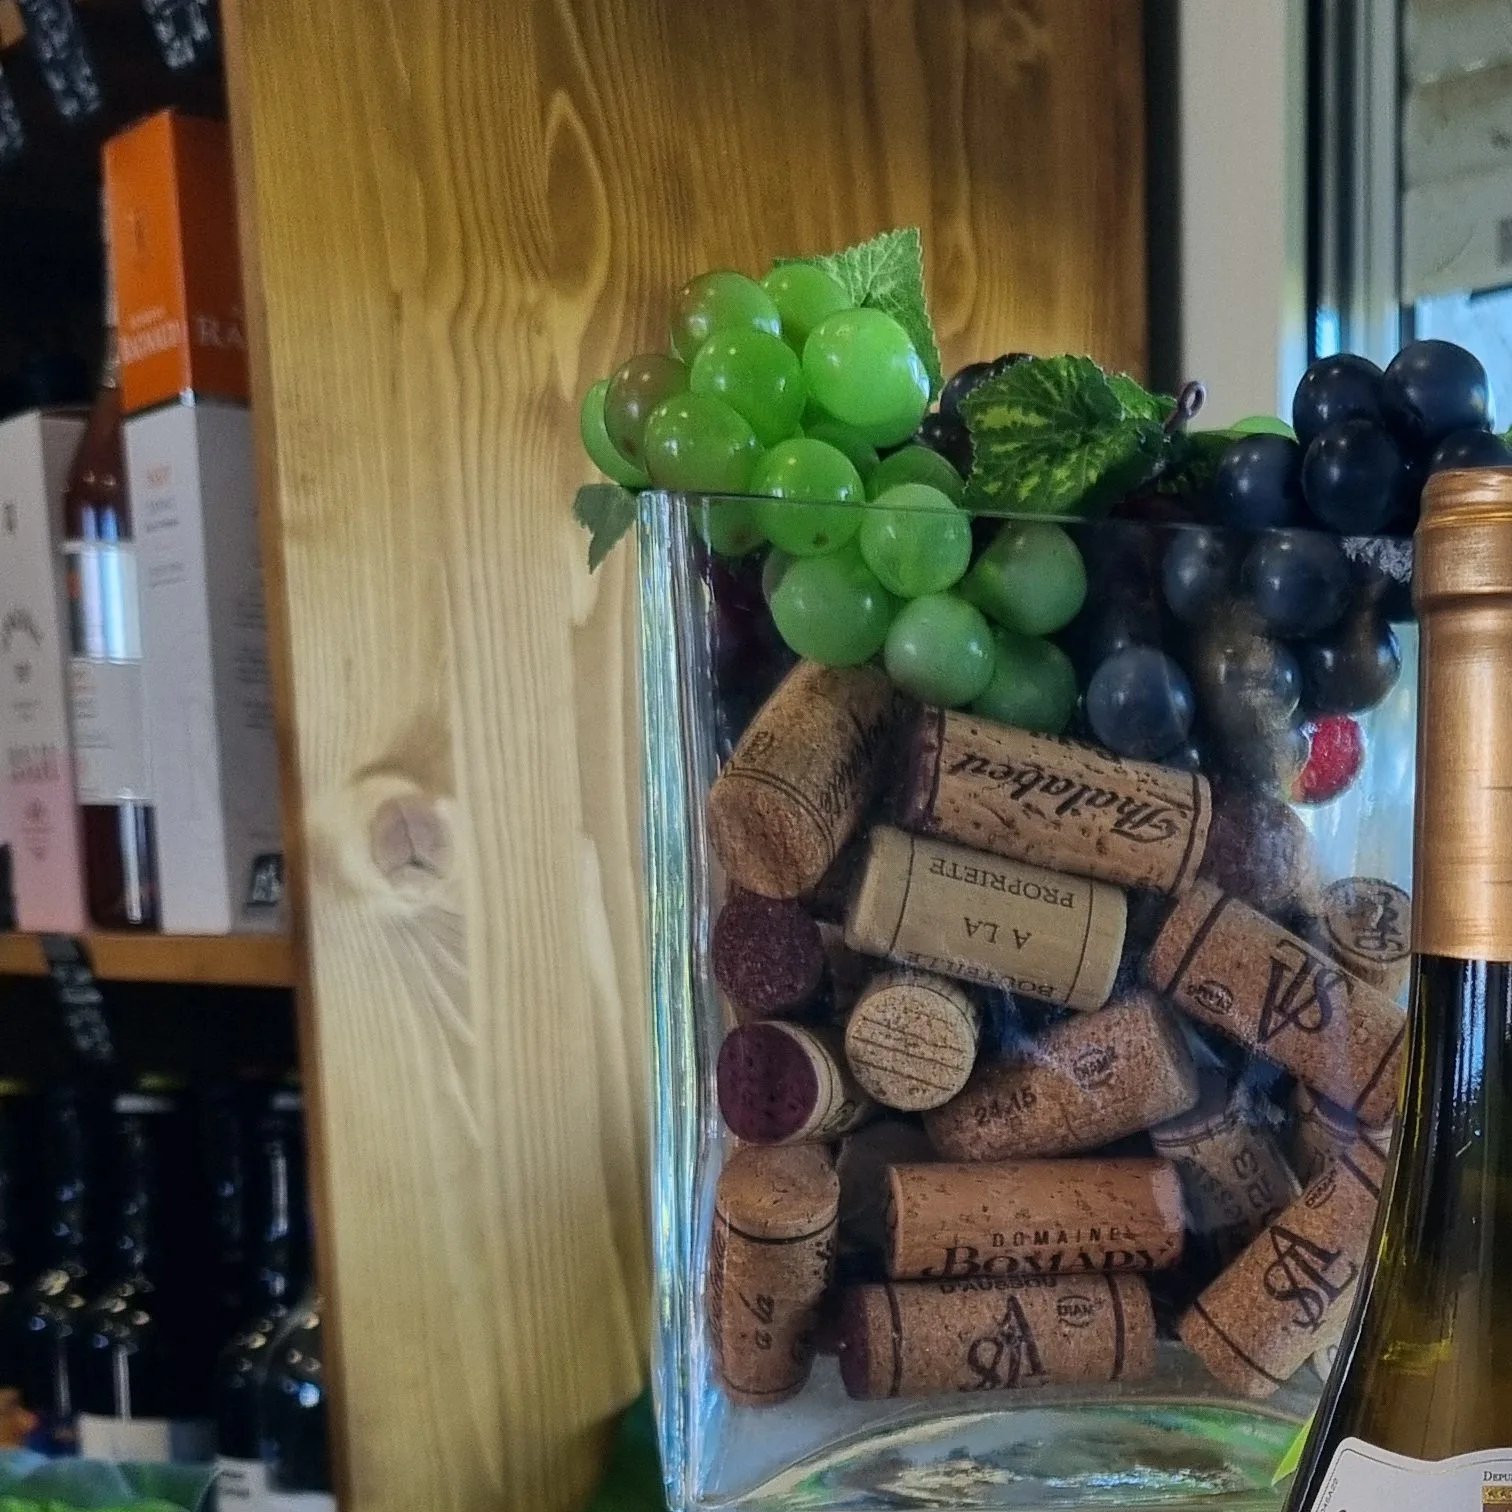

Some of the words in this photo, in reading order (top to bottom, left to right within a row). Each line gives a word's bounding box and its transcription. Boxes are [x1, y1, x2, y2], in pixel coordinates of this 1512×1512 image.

[929, 855, 1075, 909] PROPRIETE
[963, 915, 1000, 945] LA
[1013, 928, 1033, 950] A
[992, 1227, 1119, 1248] DOMAINE
